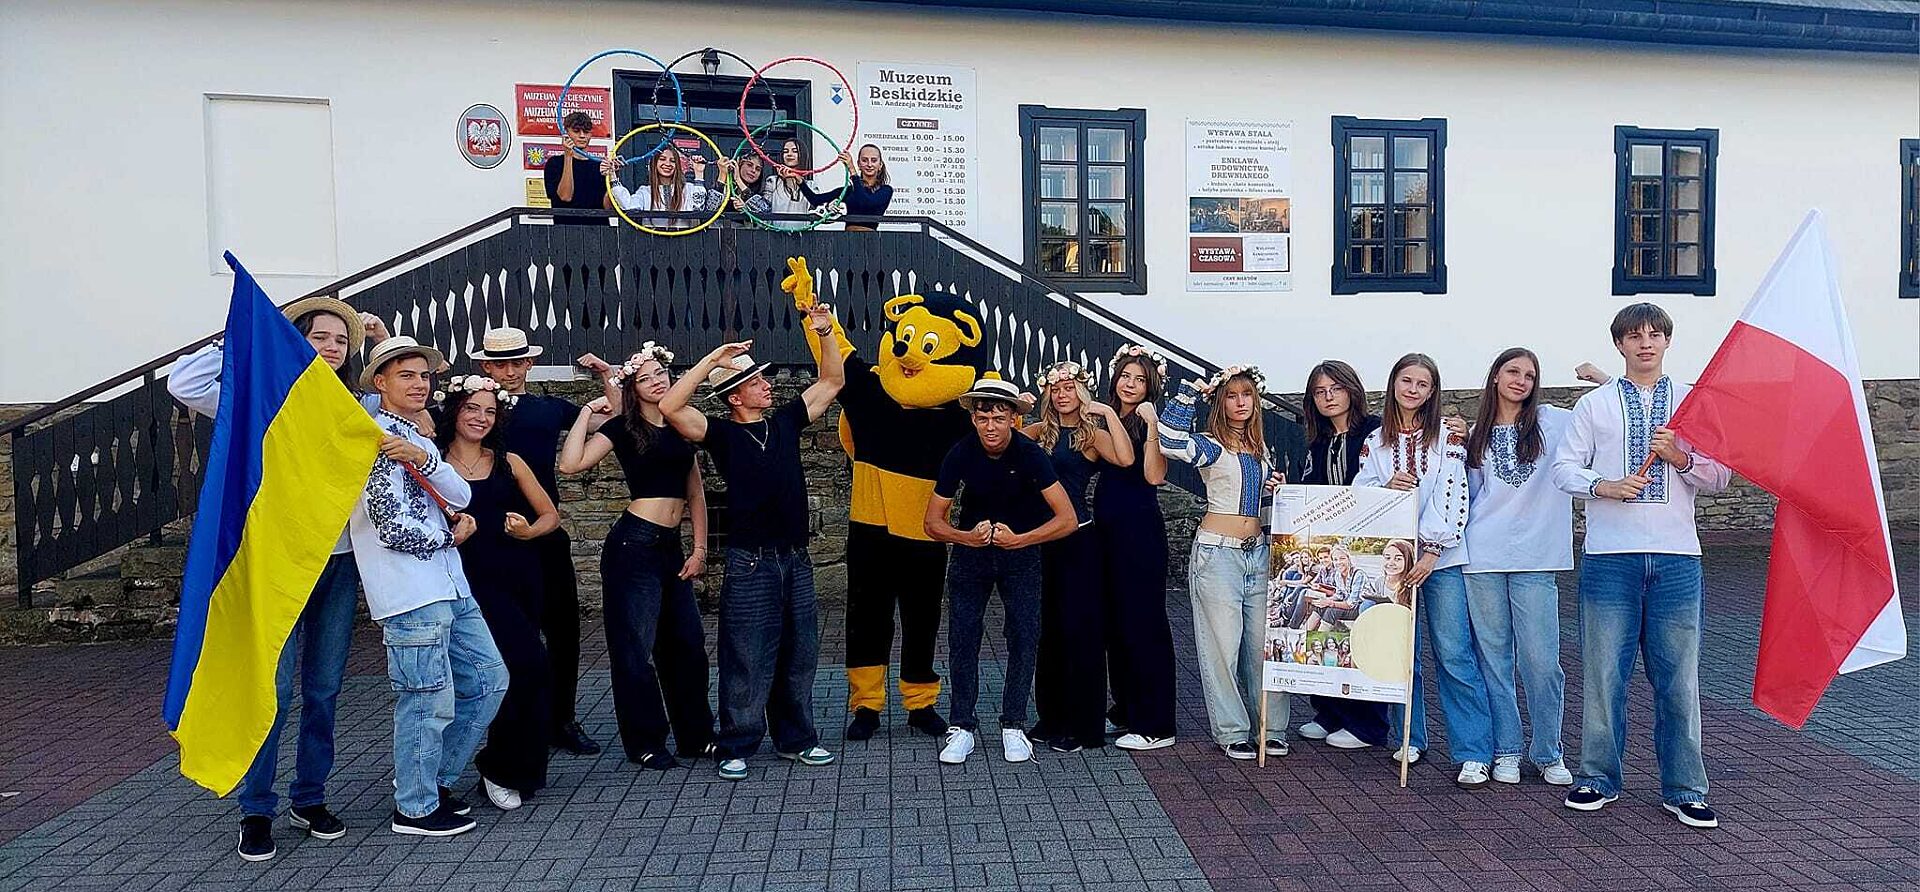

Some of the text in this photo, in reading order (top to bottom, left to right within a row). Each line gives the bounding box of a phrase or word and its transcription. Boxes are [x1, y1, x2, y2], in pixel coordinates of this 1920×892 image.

[879, 70, 952, 86] Muzeum
[524, 92, 556, 101] MUZEUM
[568, 94, 604, 103] CIESZYNIE
[869, 86, 963, 102] Beskidzkie
[523, 107, 558, 117] MUZEUM
[911, 133, 934, 141] 10.00
[1207, 129, 1246, 137] WYSTAWA
[1211, 164, 1269, 172] BUDOWNICTWA
[944, 187, 966, 195] 15.30
[1198, 247, 1236, 255] WYSTAWA
